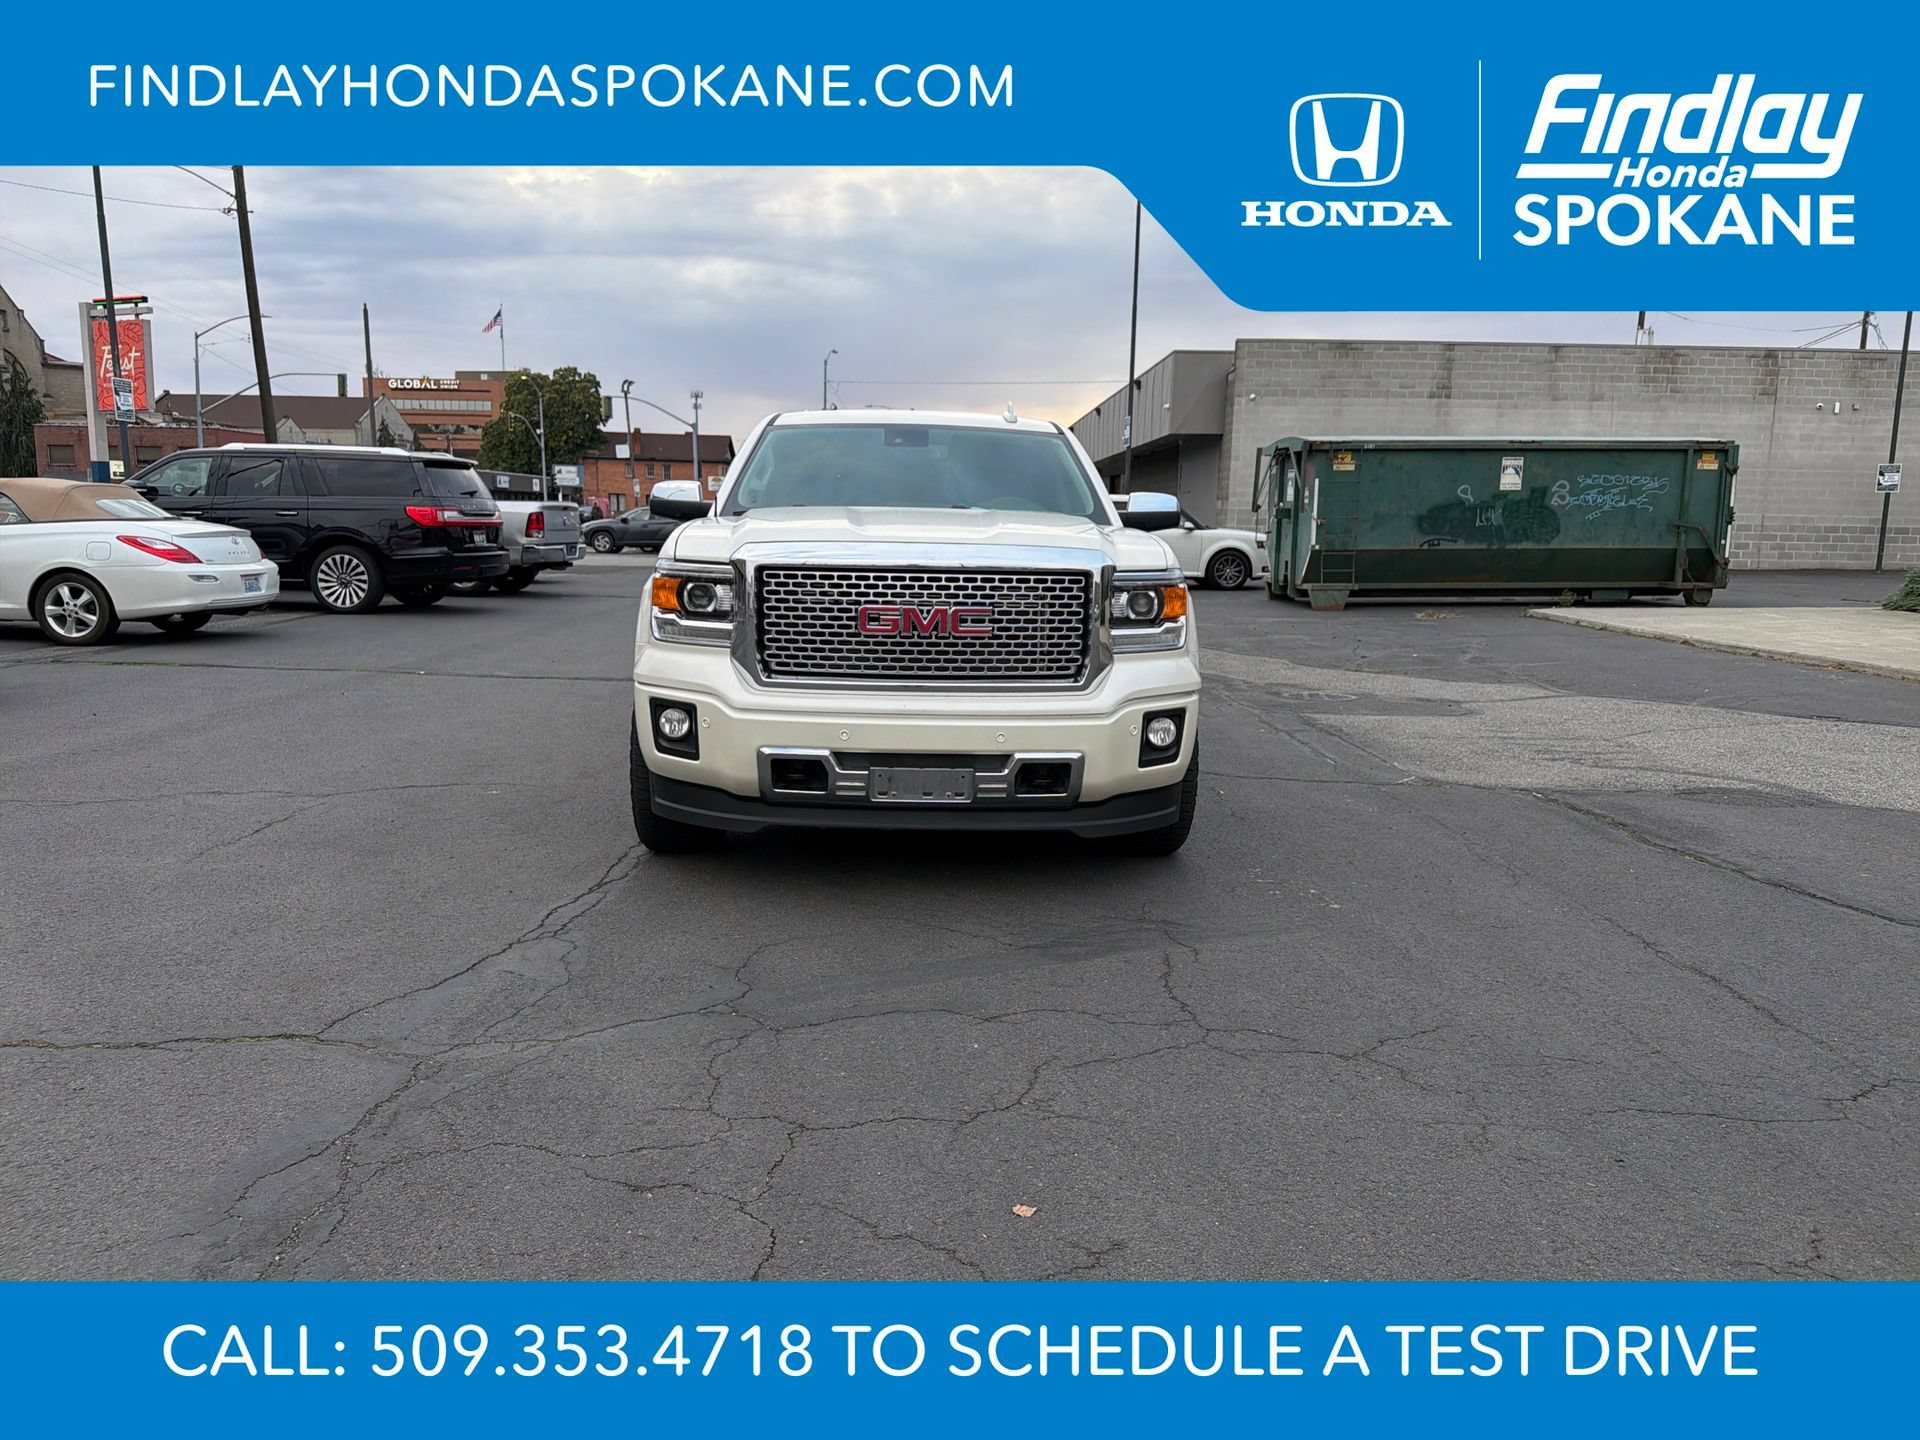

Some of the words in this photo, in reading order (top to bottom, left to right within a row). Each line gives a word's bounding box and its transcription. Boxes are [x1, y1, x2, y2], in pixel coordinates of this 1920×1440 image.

[100, 345, 141, 378] Fest
[388, 377, 437, 389] GLOBAL
[858, 604, 993, 637] GMC
